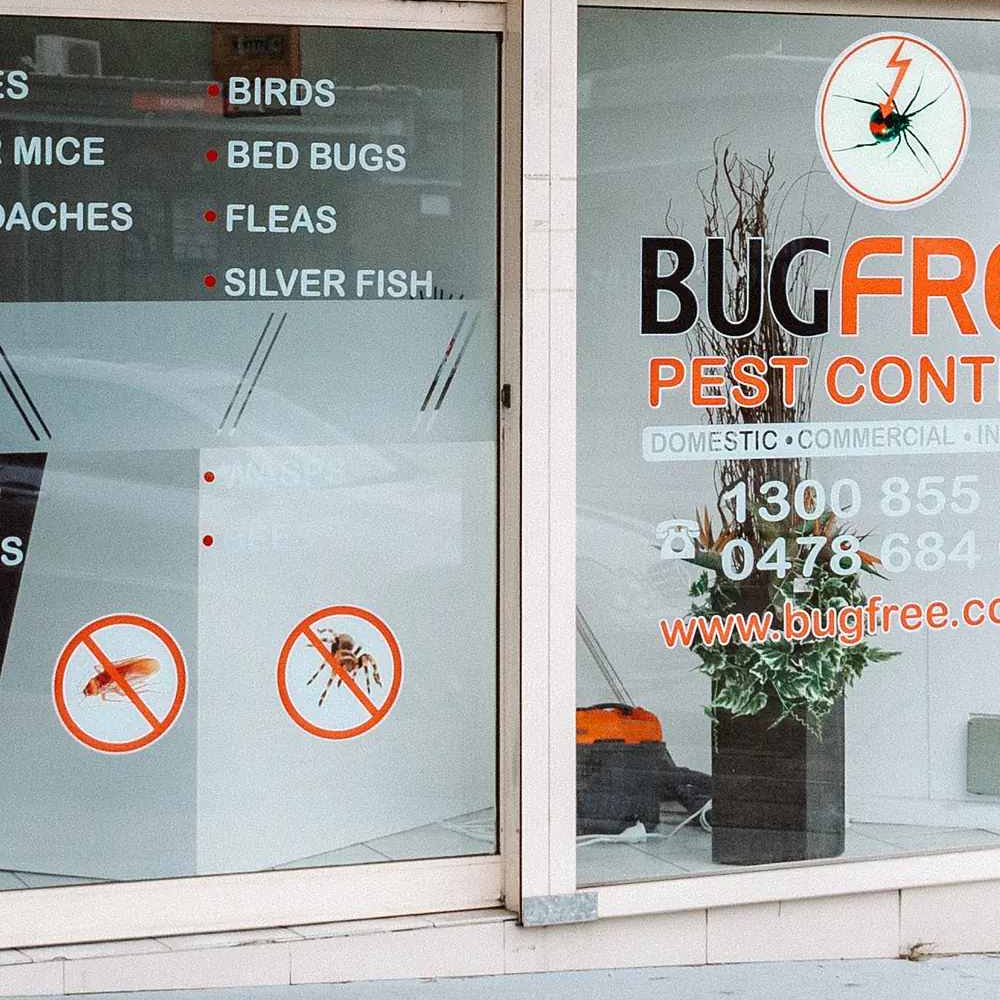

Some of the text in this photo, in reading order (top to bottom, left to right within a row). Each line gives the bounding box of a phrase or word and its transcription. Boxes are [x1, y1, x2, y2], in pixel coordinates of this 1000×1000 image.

[0, 70, 29, 100] S
[228, 77, 336, 108] BIRDS
[14, 136, 105, 166] MICE
[227, 140, 407, 172] BED BUGS
[0, 202, 133, 232] ACHES
[225, 204, 337, 234] FLEAS
[224, 268, 433, 298] SILVER FISH
[648, 357, 808, 408] PEST
[650, 429, 779, 453] DOMESTIC
[797, 426, 956, 450] COMMERCIAL
[722, 478, 861, 523] 1300
[880, 474, 980, 518] 855
[721, 534, 862, 581] 0478
[880, 530, 980, 574] 684
